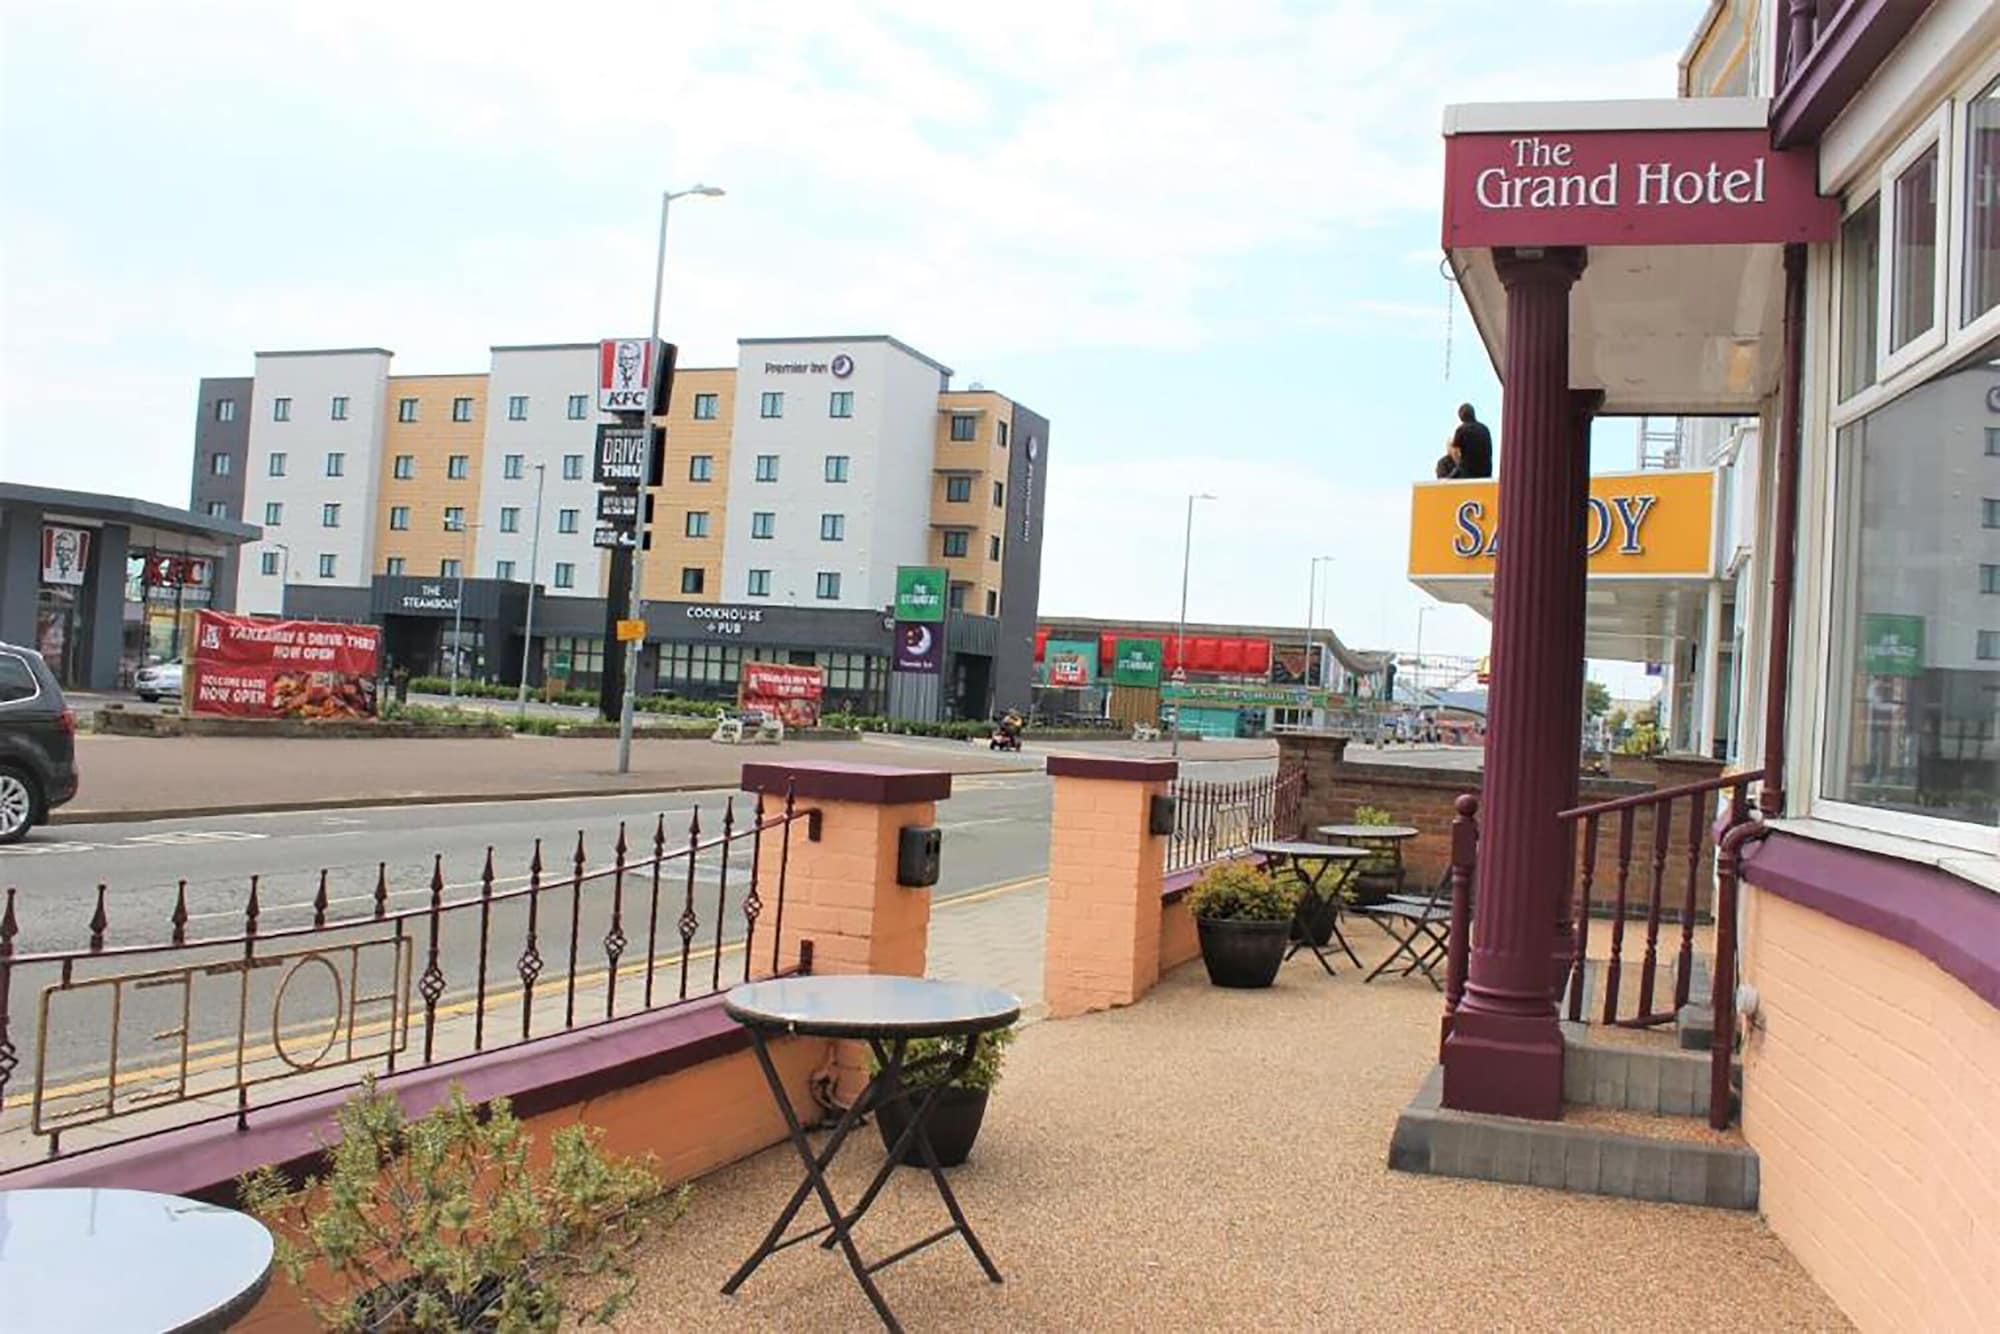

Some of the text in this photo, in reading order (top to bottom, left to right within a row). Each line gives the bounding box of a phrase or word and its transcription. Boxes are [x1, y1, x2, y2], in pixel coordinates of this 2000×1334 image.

[1510, 137, 1571, 167] The
[1476, 157, 1765, 208] Grand Hotel
[608, 391, 645, 406] KFC
[422, 584, 440, 596] THE
[403, 596, 460, 609] STEAMBOAT
[686, 606, 763, 621] COOKHOUSE
[718, 622, 741, 633] PUB
[303, 647, 335, 660] OPEN
[232, 688, 267, 703] OPEN
